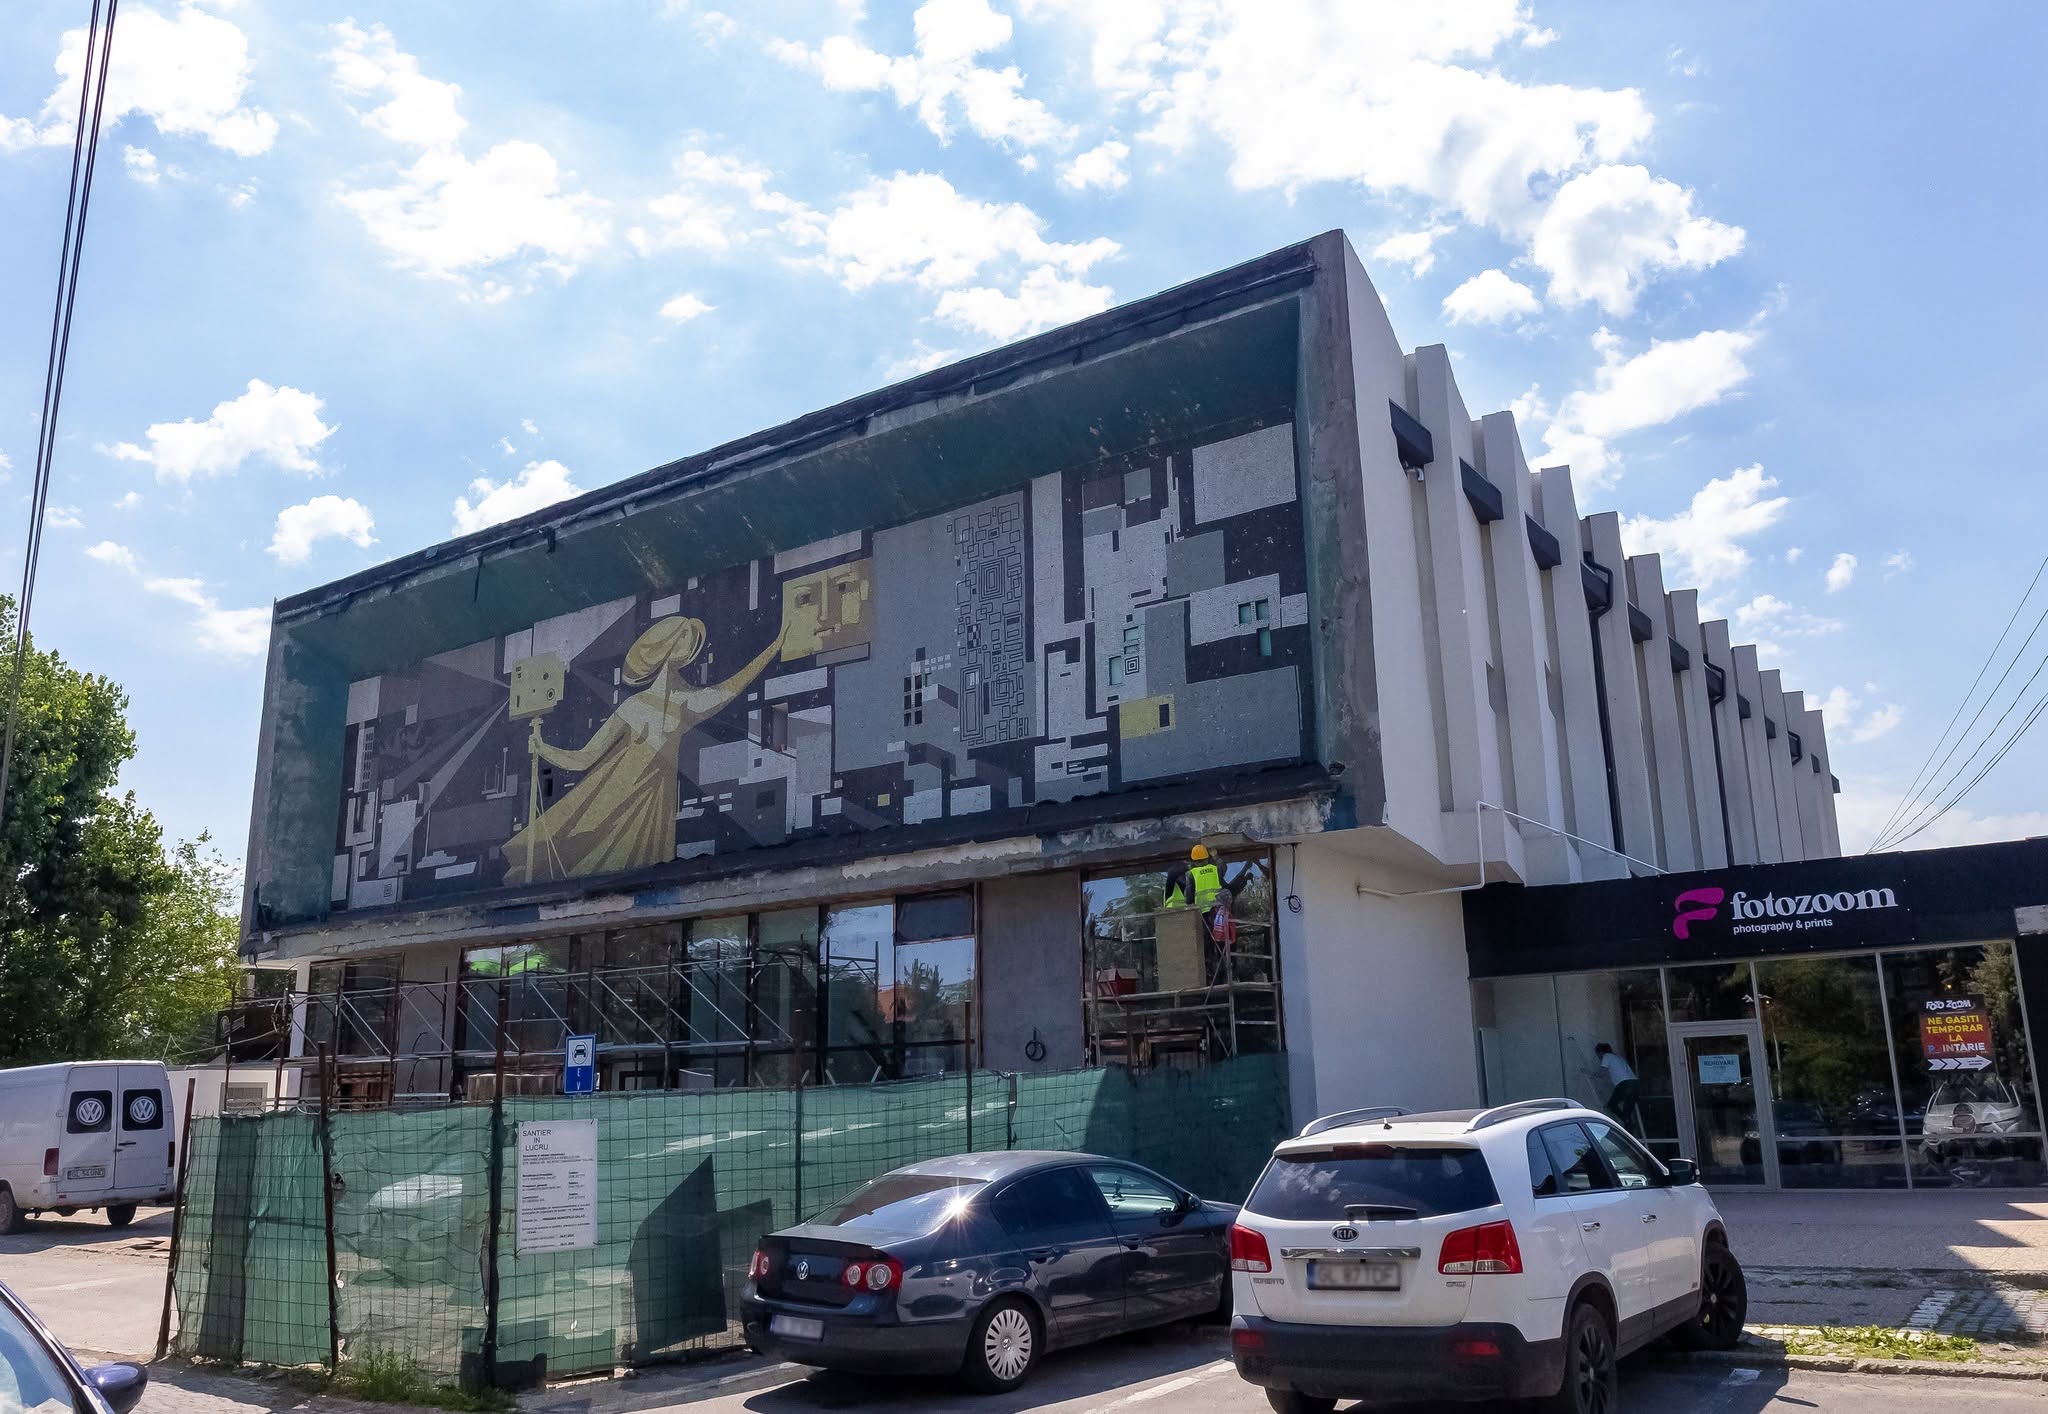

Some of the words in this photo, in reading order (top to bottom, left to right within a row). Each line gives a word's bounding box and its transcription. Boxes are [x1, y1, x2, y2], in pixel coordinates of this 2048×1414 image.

[1730, 888, 1899, 920] fotozoom
[1733, 921, 1794, 935] photography
[1795, 919, 1803, 929] &
[1804, 918, 1833, 930] prints
[1927, 1016, 1943, 1025] NE
[1945, 1015, 1979, 1024] GASITI
[1926, 1024, 1984, 1034] TEMPORAR
[1948, 1034, 1964, 1042] LA
[522, 1129, 552, 1137] SANTIER
[525, 1143, 549, 1151] LUCRU
[1336, 1229, 1354, 1239] KIA
